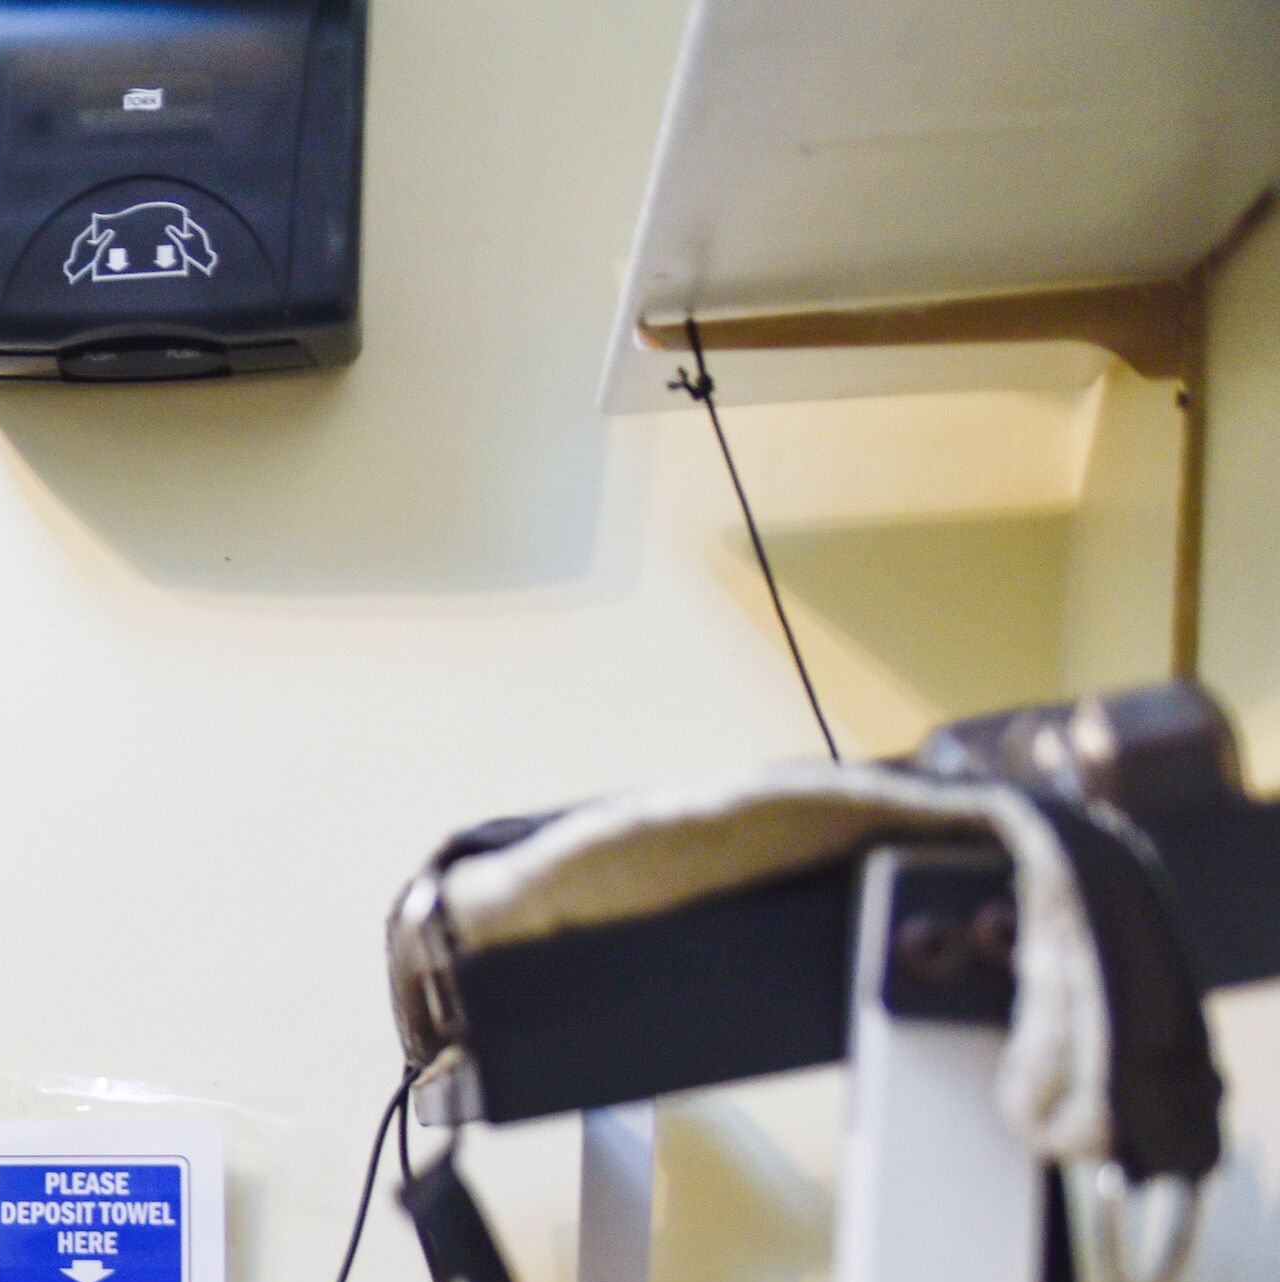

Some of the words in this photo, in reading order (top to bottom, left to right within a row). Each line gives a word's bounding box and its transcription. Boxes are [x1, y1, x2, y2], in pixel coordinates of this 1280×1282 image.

[45, 1172, 130, 1195] PLEASE
[0, 1201, 96, 1225] DEPOSIT
[98, 1202, 176, 1226] TOWEL
[57, 1231, 119, 1254] HERE
